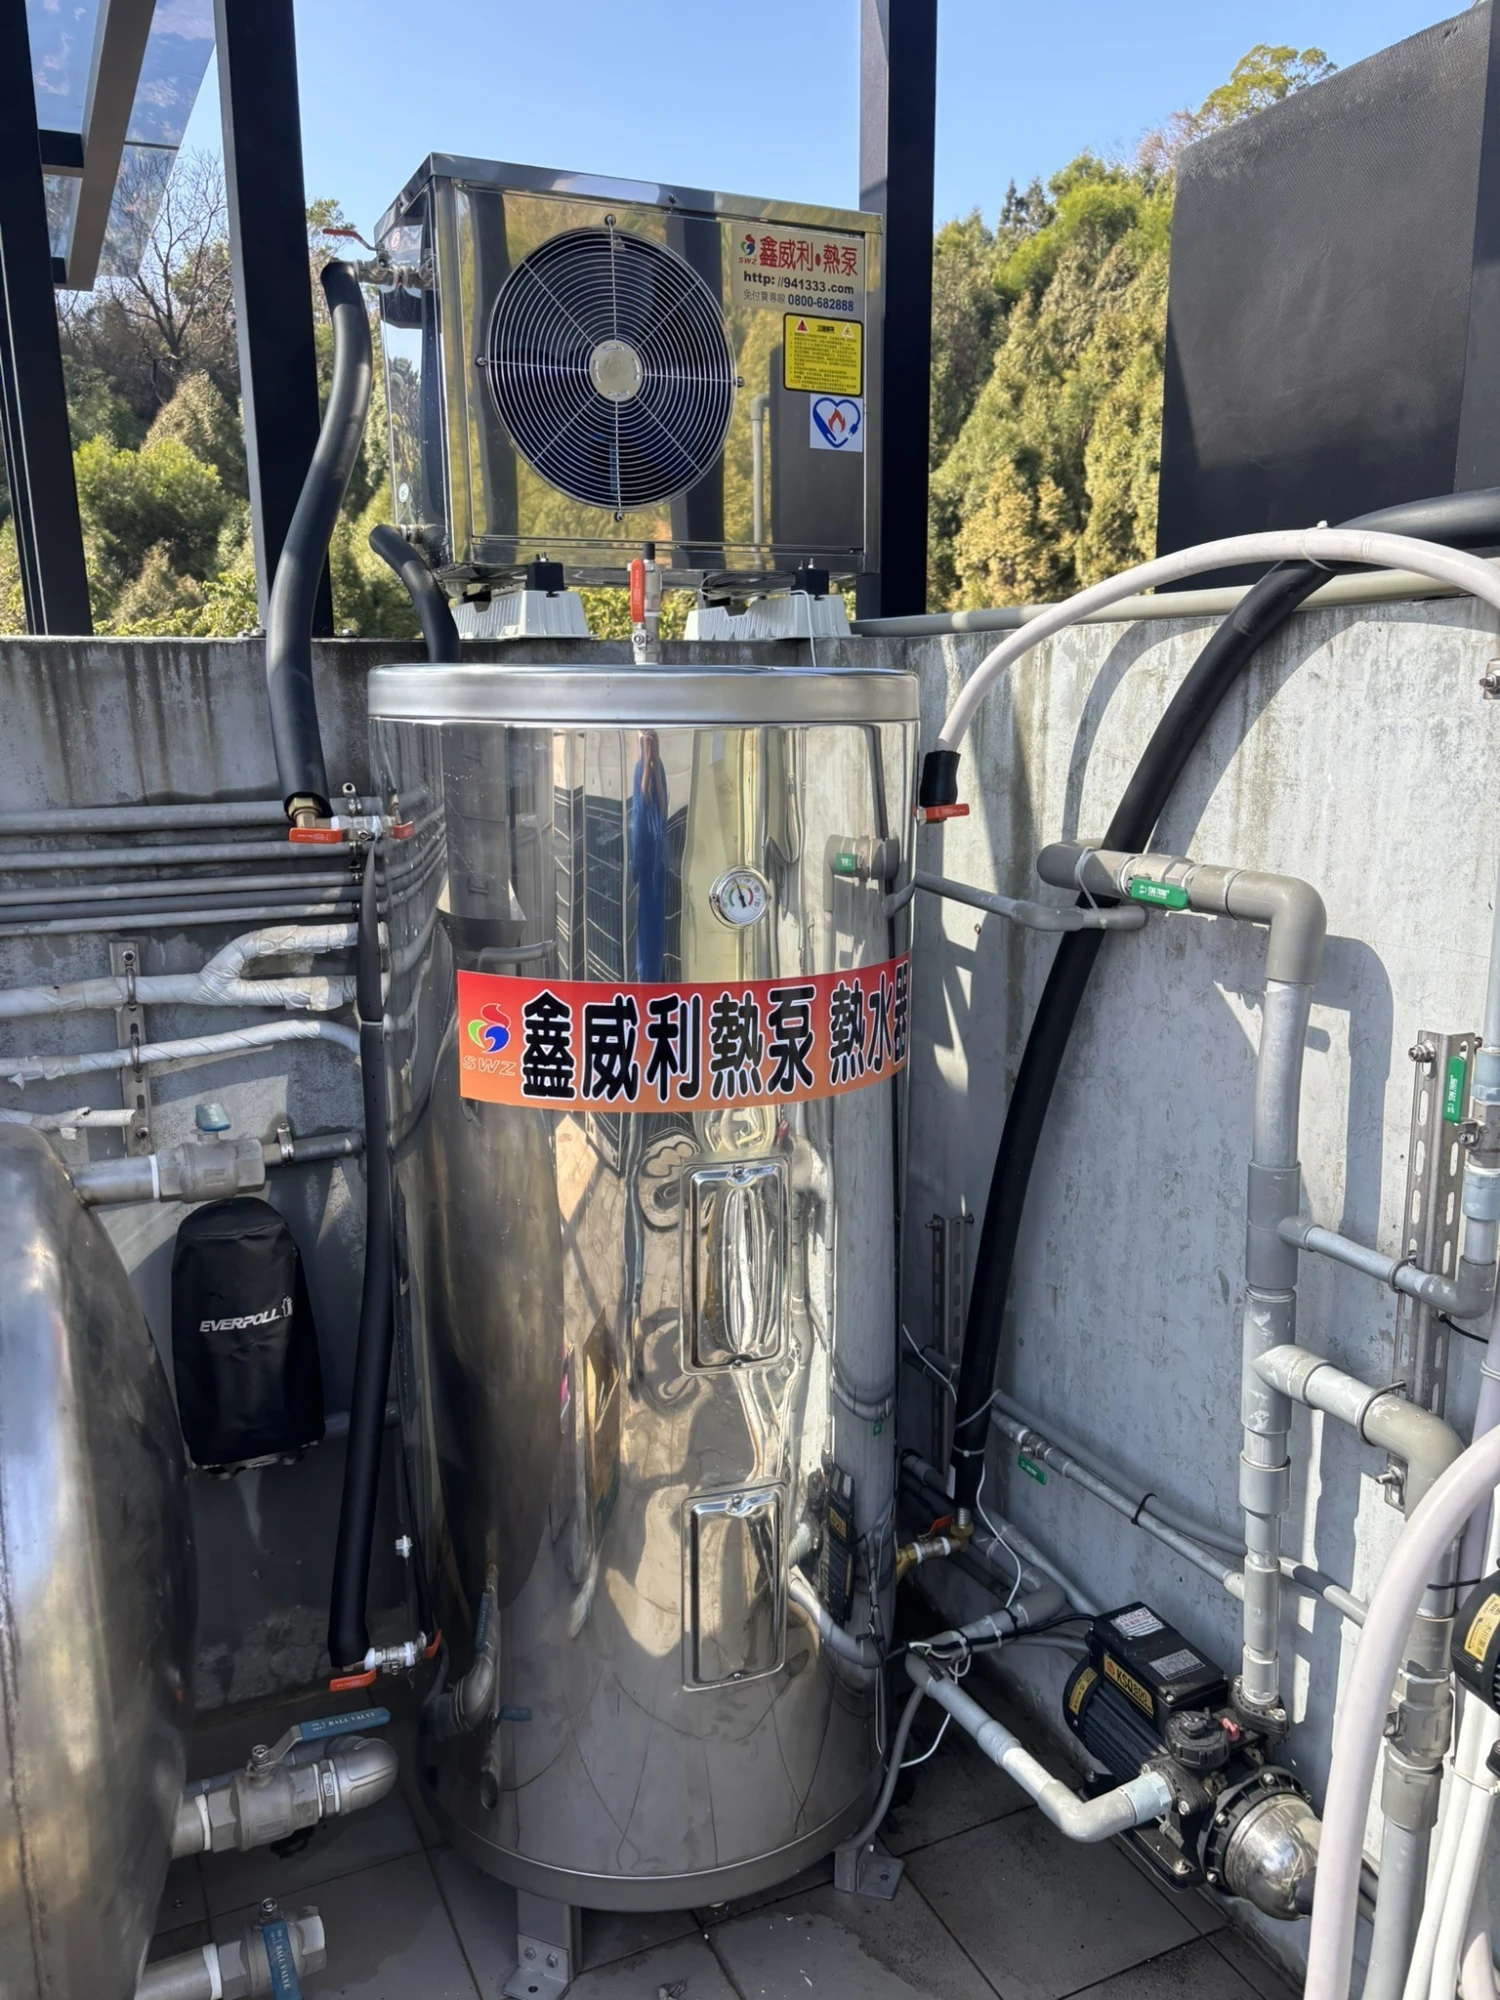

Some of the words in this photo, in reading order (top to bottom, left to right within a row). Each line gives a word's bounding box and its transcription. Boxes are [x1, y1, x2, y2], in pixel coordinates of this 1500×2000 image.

[788, 294, 854, 311] 0800-682888
[463, 1055, 517, 1076] SWZ
[199, 1308, 280, 1332] EVERPOLL
[328, 1717, 350, 1726] BALL
[350, 1712, 376, 1721] VALVE
[276, 1945, 285, 1965] BALL
[280, 1964, 291, 1990] VALVE
